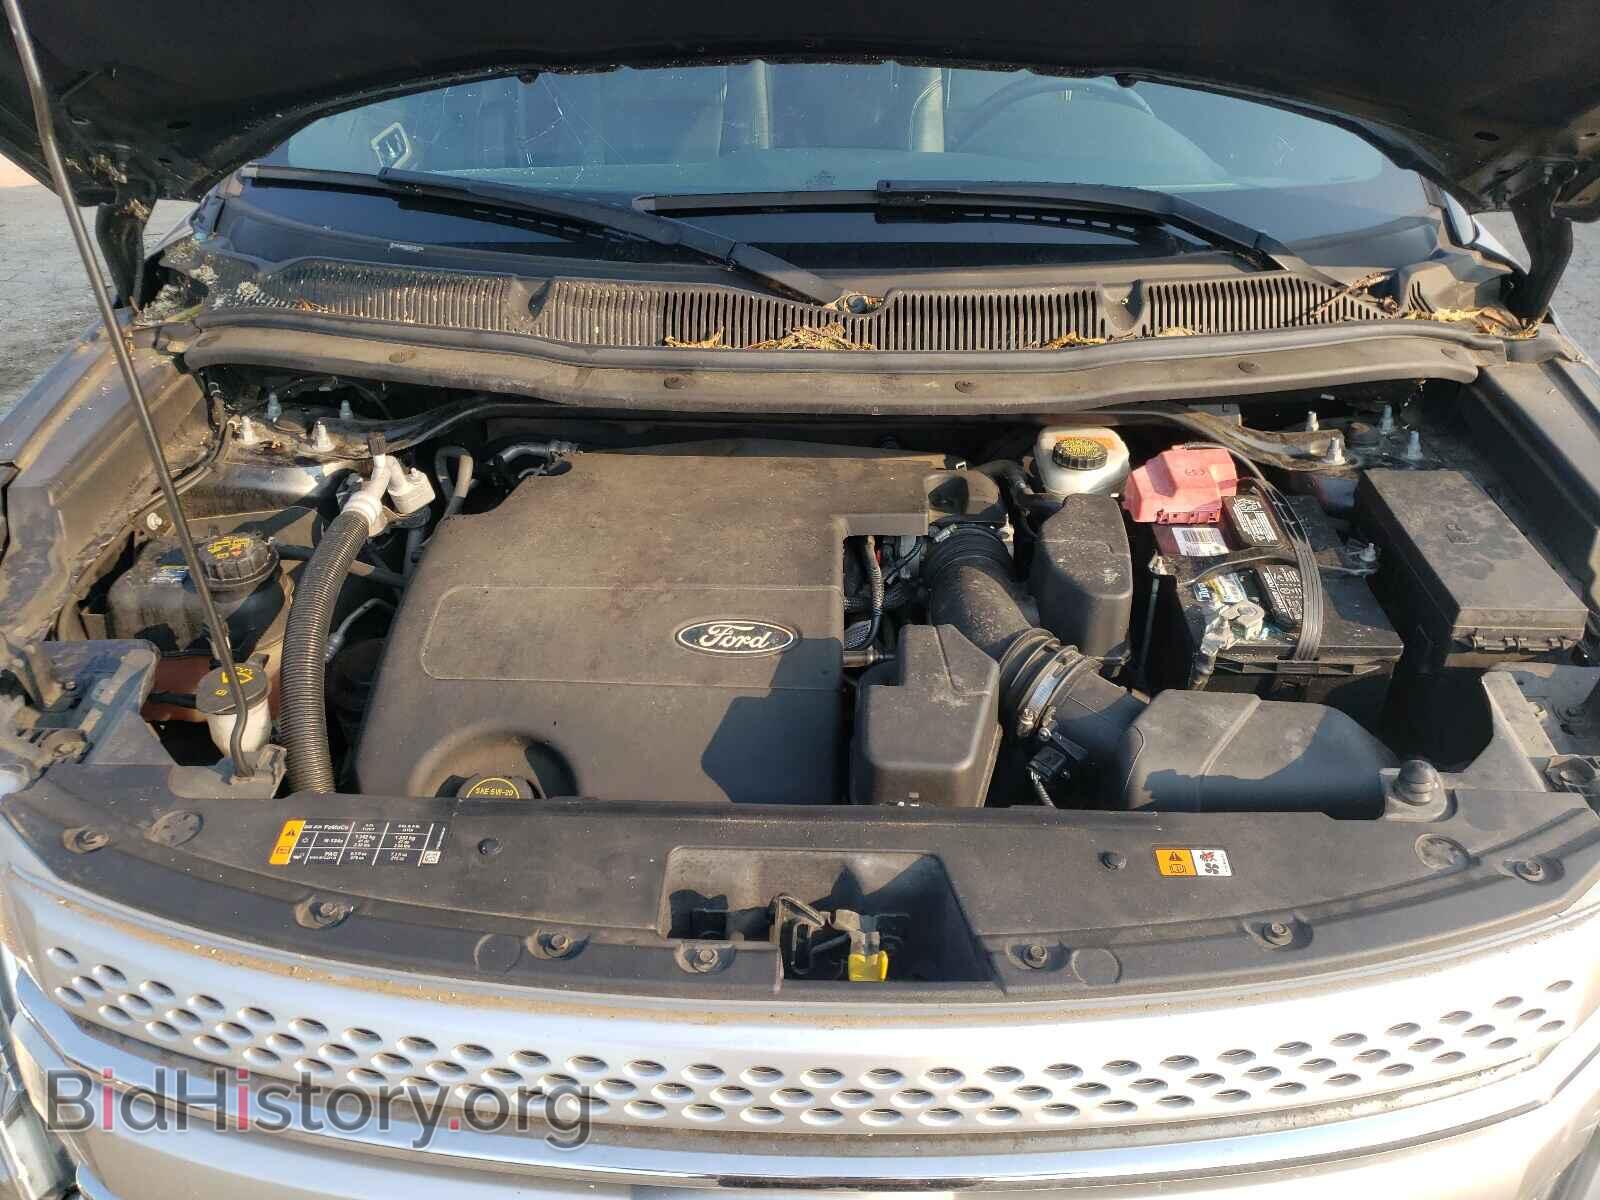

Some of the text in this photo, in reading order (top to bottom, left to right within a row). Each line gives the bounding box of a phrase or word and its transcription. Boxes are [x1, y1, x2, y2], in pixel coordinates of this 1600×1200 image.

[699, 624, 773, 648] Ford
[475, 787, 514, 797] SAE 5W-20
